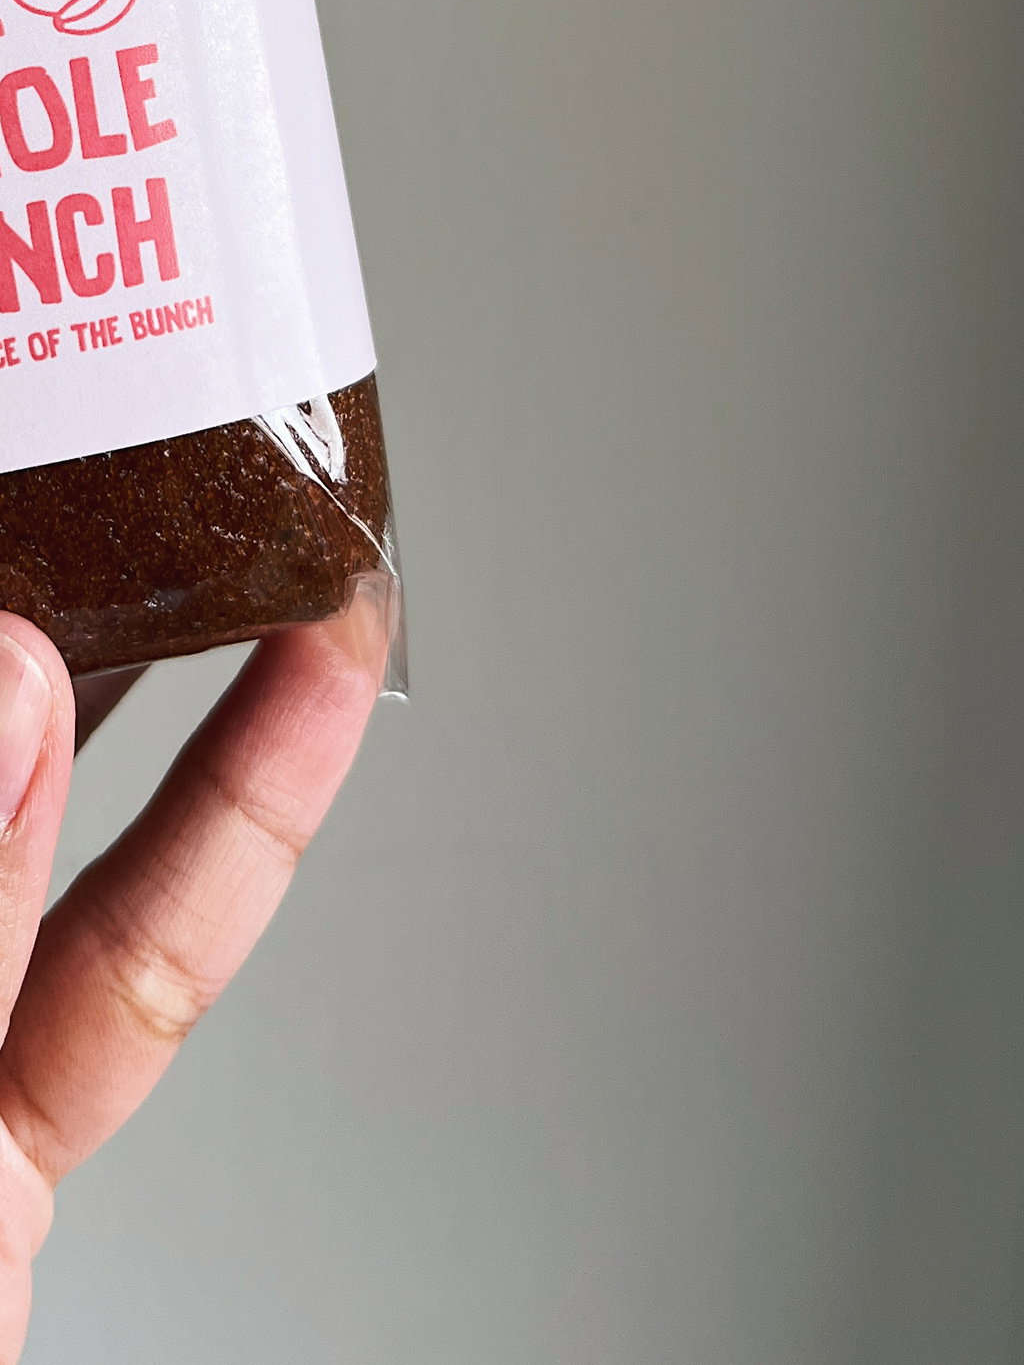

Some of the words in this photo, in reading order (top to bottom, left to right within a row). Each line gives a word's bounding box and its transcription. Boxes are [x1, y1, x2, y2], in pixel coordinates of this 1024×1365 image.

[28, 327, 61, 362] OF
[70, 315, 124, 353] THE
[129, 296, 214, 341] BUNCH
